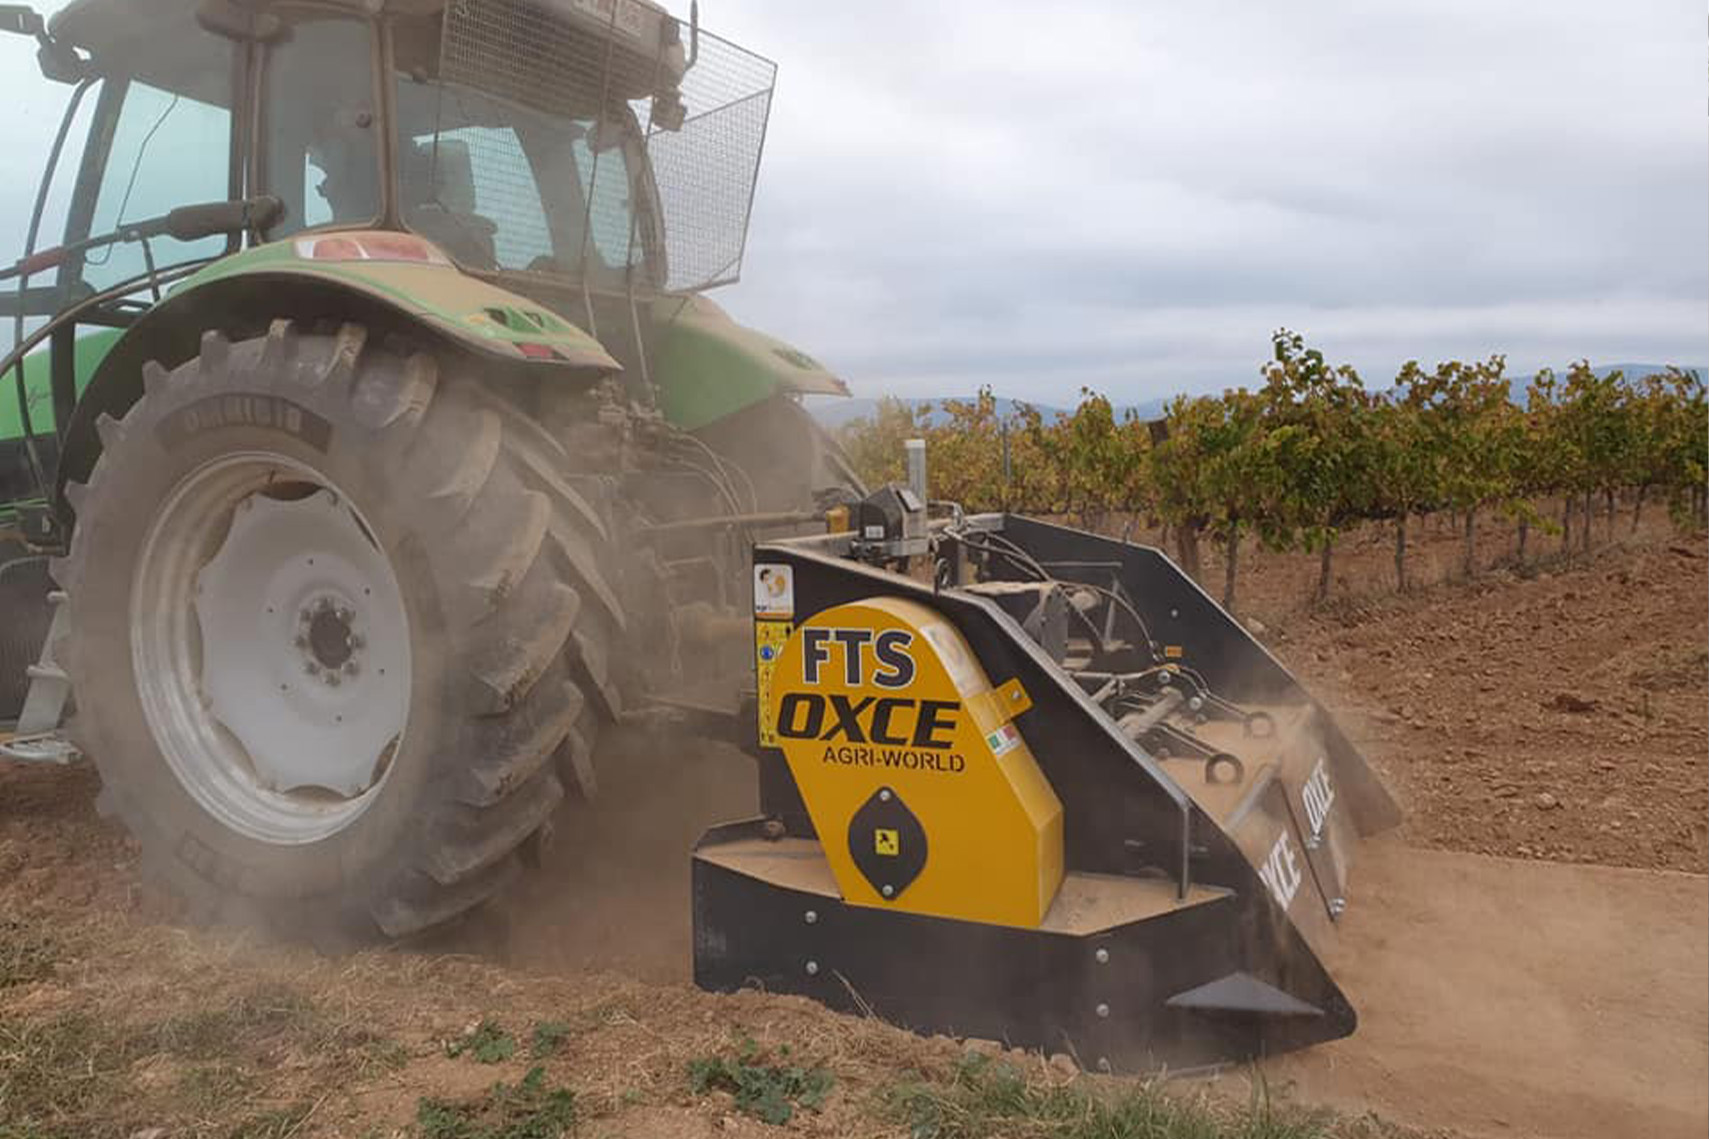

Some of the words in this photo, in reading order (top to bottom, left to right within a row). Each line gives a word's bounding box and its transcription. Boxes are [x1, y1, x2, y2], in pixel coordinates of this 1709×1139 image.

[803, 627, 915, 689] FTS
[776, 692, 961, 749] OXCE
[823, 746, 965, 773] AGRI-WORLD
